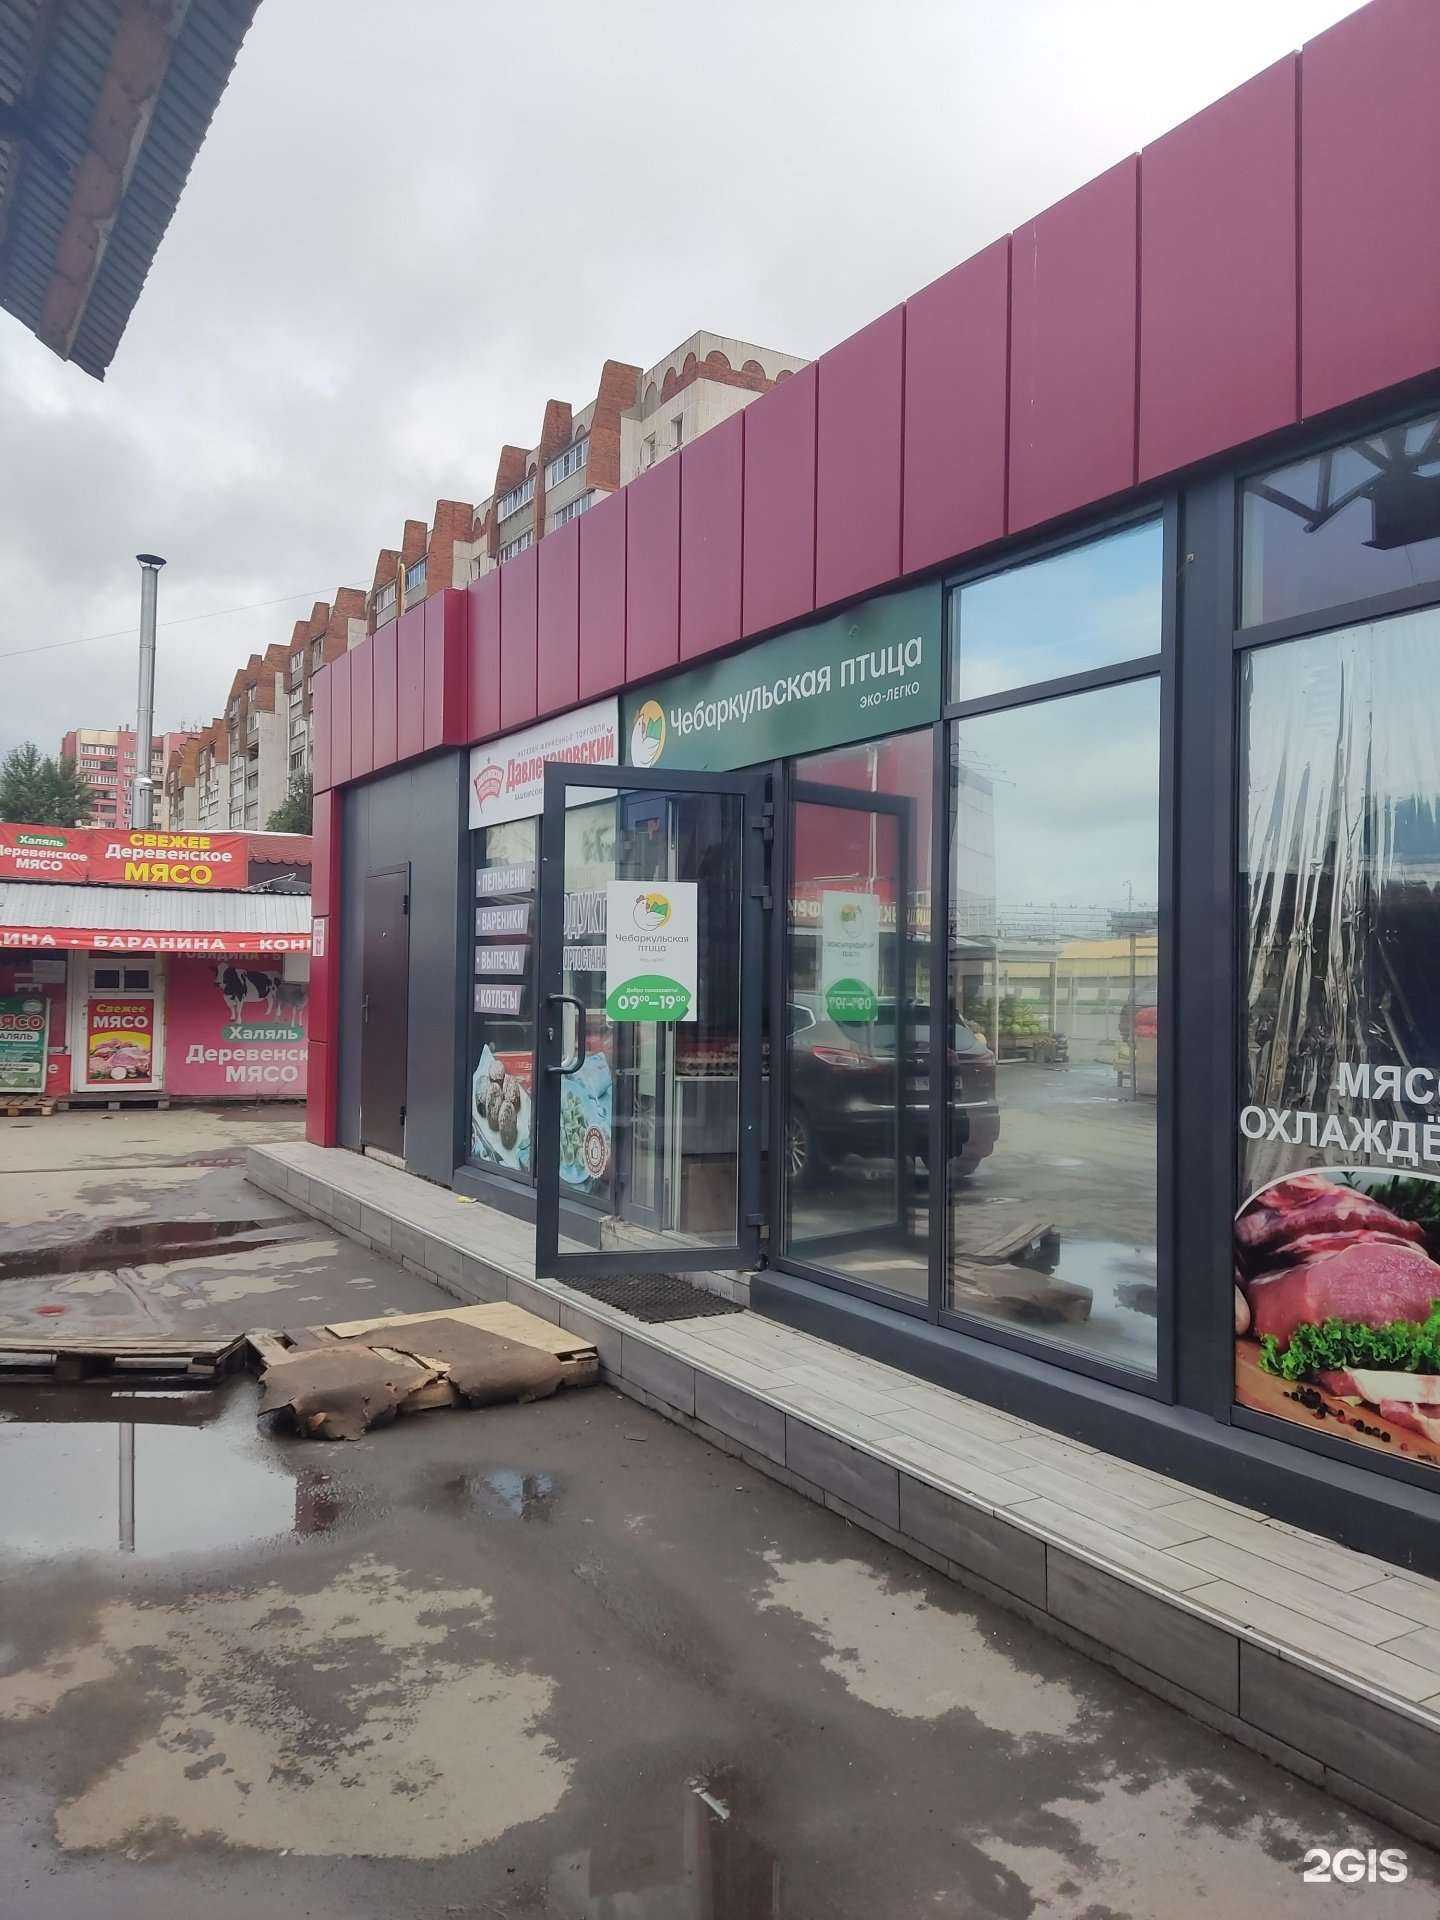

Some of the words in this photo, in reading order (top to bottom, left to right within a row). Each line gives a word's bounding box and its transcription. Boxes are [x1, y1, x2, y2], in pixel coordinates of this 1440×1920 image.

[670, 665, 831, 736] Чебаркульская
[840, 636, 922, 688] птица
[859, 681, 920, 709] ЭКО-ЛЕГКО
[20, 835, 64, 847] Халяль
[129, 833, 211, 849] СВЕЖЕЕ
[105, 843, 232, 861] Деревенское
[16, 858, 63, 871] МЯСО
[124, 862, 213, 884] МЯСО
[482, 868, 526, 891] ПЕЛЬМЕНИ
[482, 910, 524, 931] ВАРЕНИКИ
[93, 936, 225, 950] БАРАНИНА
[616, 933, 689, 944] Чебаркульская
[638, 945, 667, 953] птица
[481, 951, 520, 970] ВЫПЕЧКА
[480, 988, 518, 1009] КОТЛЕТЫ
[93, 1016, 148, 1028] МЯСО
[229, 1026, 298, 1040] Халяль
[225, 1066, 298, 1082] МЯСО
[1338, 1062, 1440, 1105] МЯС
